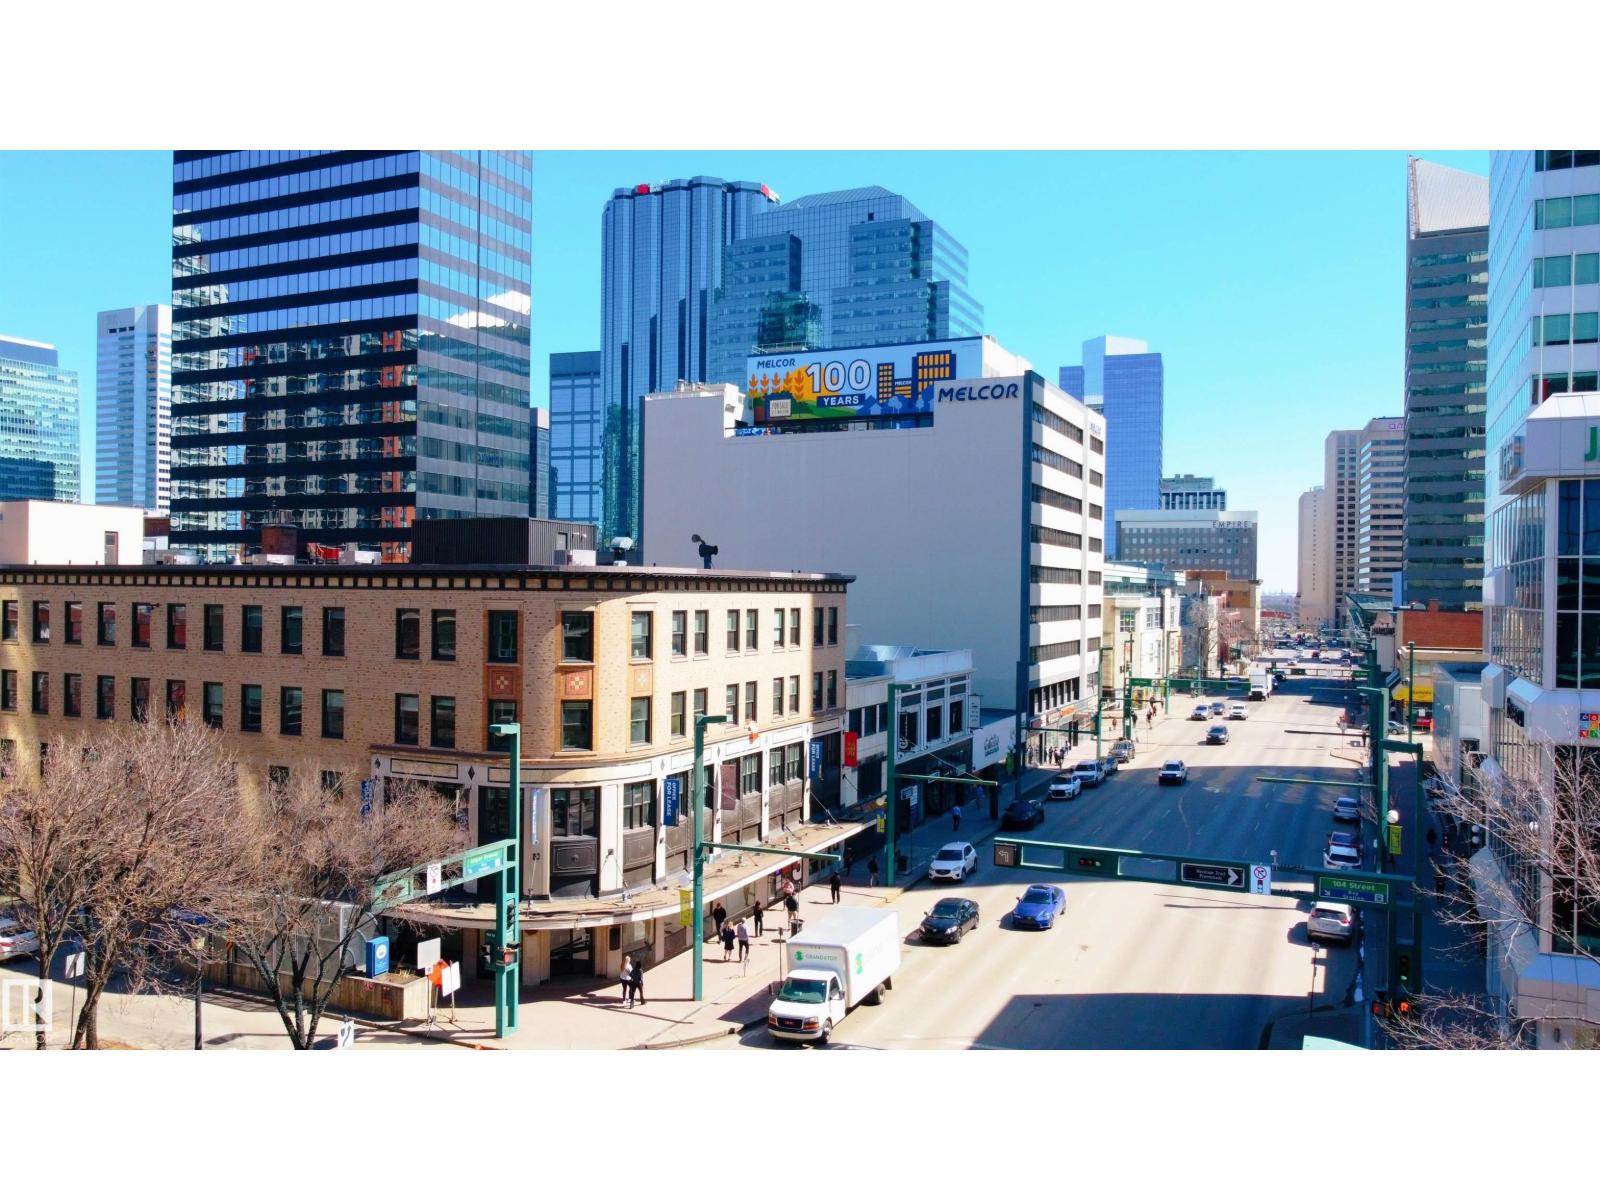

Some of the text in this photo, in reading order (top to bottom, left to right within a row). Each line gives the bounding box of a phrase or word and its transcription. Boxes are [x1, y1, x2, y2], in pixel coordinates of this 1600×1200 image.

[757, 358, 796, 369] MELCOR
[805, 359, 872, 393] 100
[937, 383, 1019, 402] MELCOR
[823, 395, 859, 406] YEARS
[1212, 520, 1248, 529] EMPIRE
[1332, 880, 1375, 891] 104 Street
